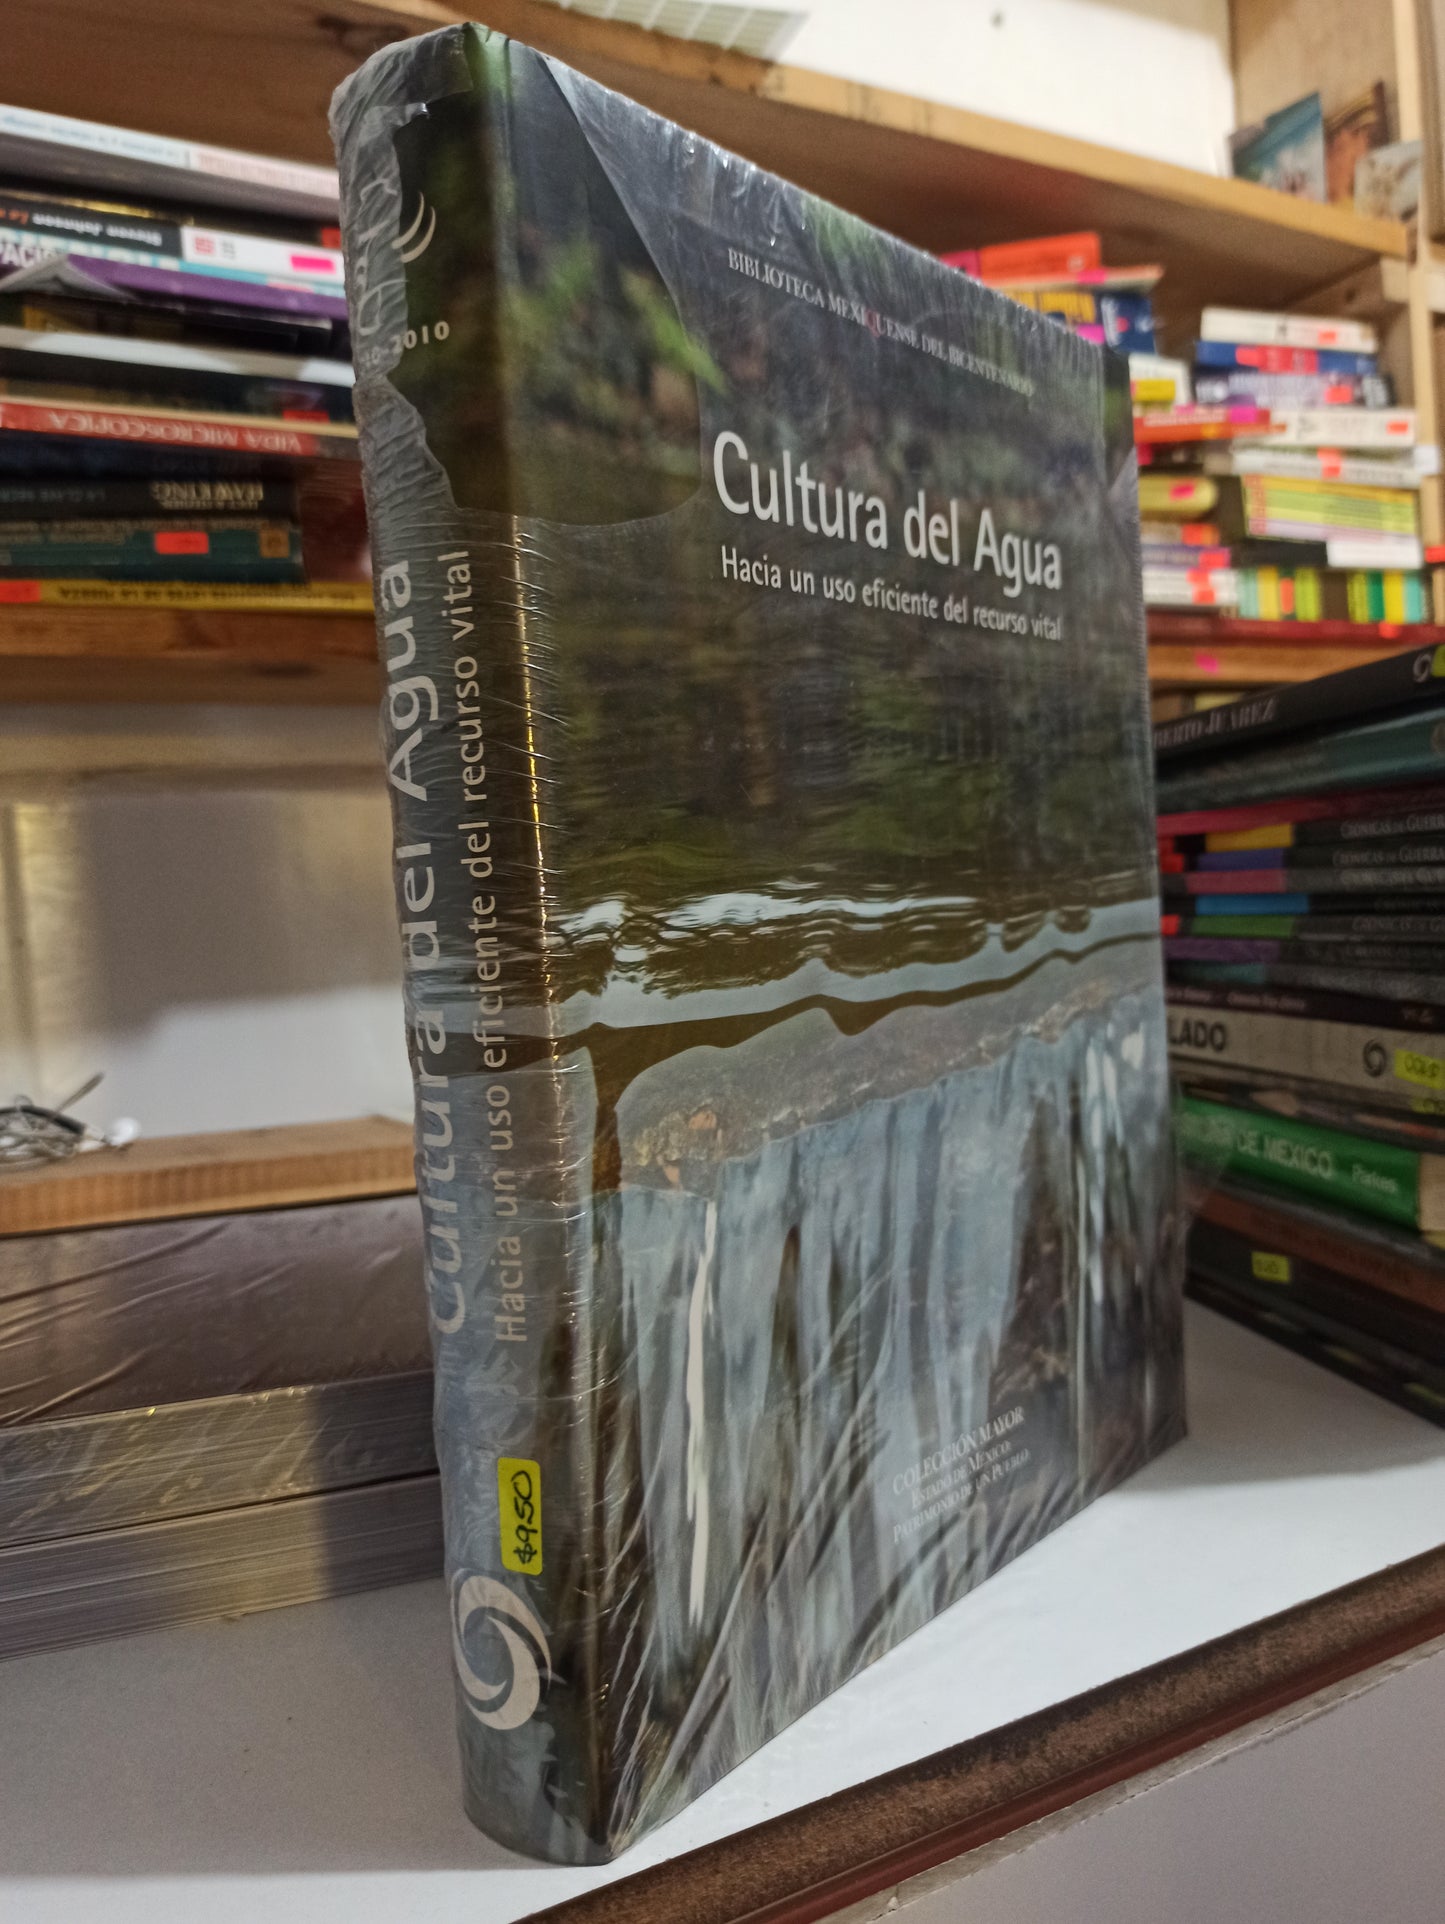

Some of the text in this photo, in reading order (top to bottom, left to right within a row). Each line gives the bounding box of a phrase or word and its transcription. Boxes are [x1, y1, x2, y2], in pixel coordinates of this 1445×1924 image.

[728, 248, 1035, 398] BIBLIOTECA MEXIQUENSE DEL BICENTENARIO
[246, 432, 302, 455] VIDA
[713, 431, 1063, 598] Cultura del Agua
[721, 545, 1063, 641] Hacia un uso eficiente del recurso vital
[379, 559, 465, 1336] Cultura del Agua
[437, 551, 529, 1344] Hacia un uso eficiente del recurso vital
[978, 1406, 1025, 1446] MAYOR
[513, 1470, 539, 1566] $950
